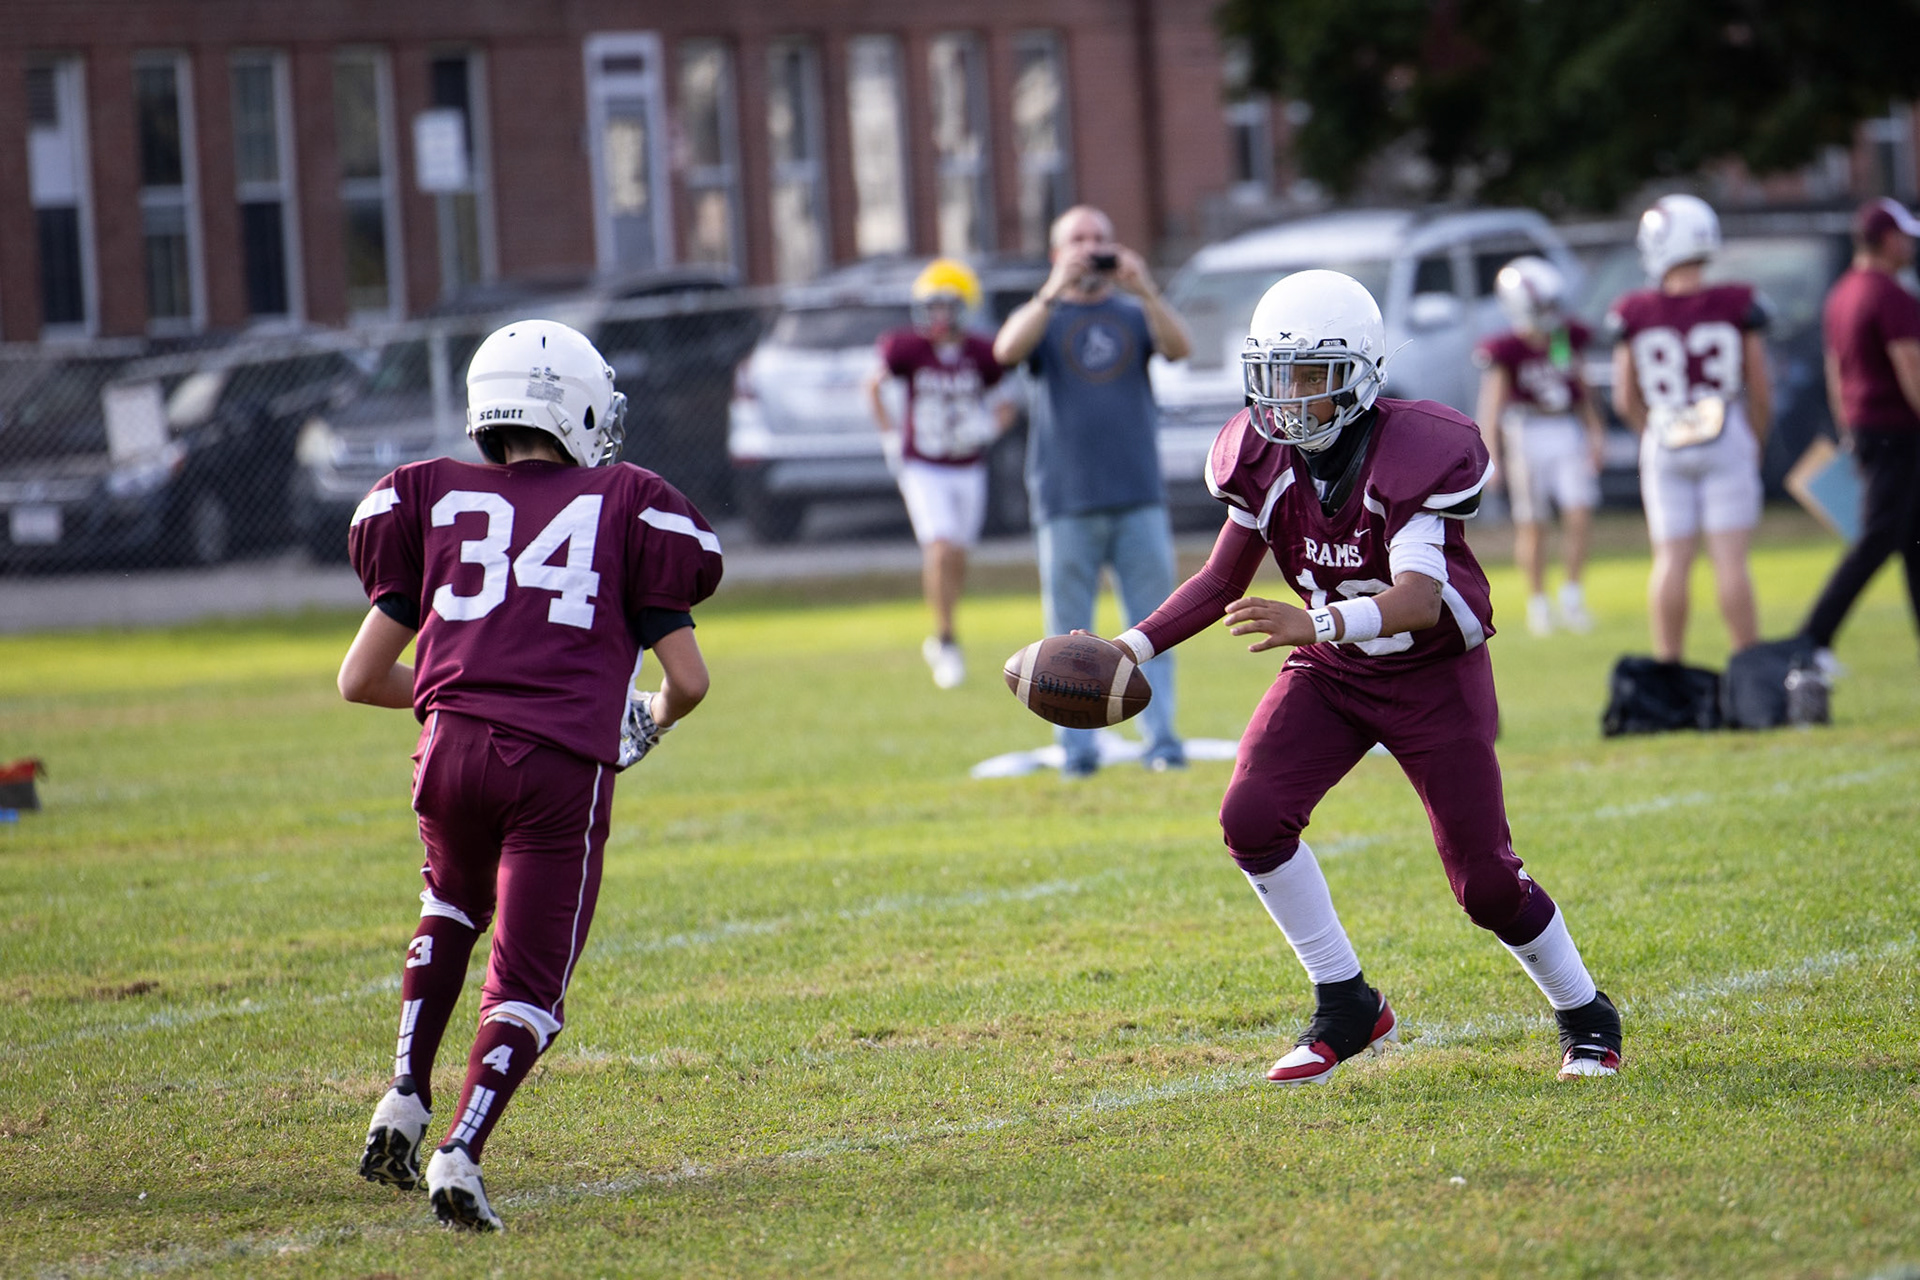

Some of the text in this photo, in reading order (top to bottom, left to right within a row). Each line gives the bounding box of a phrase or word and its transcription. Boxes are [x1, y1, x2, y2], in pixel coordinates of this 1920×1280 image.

[1633, 321, 1743, 406] 83
[479, 407, 524, 421] schutt
[431, 490, 603, 630] 34
[1303, 536, 1363, 568] RAMS
[406, 934, 434, 969] 3
[482, 1043, 514, 1076] 4
